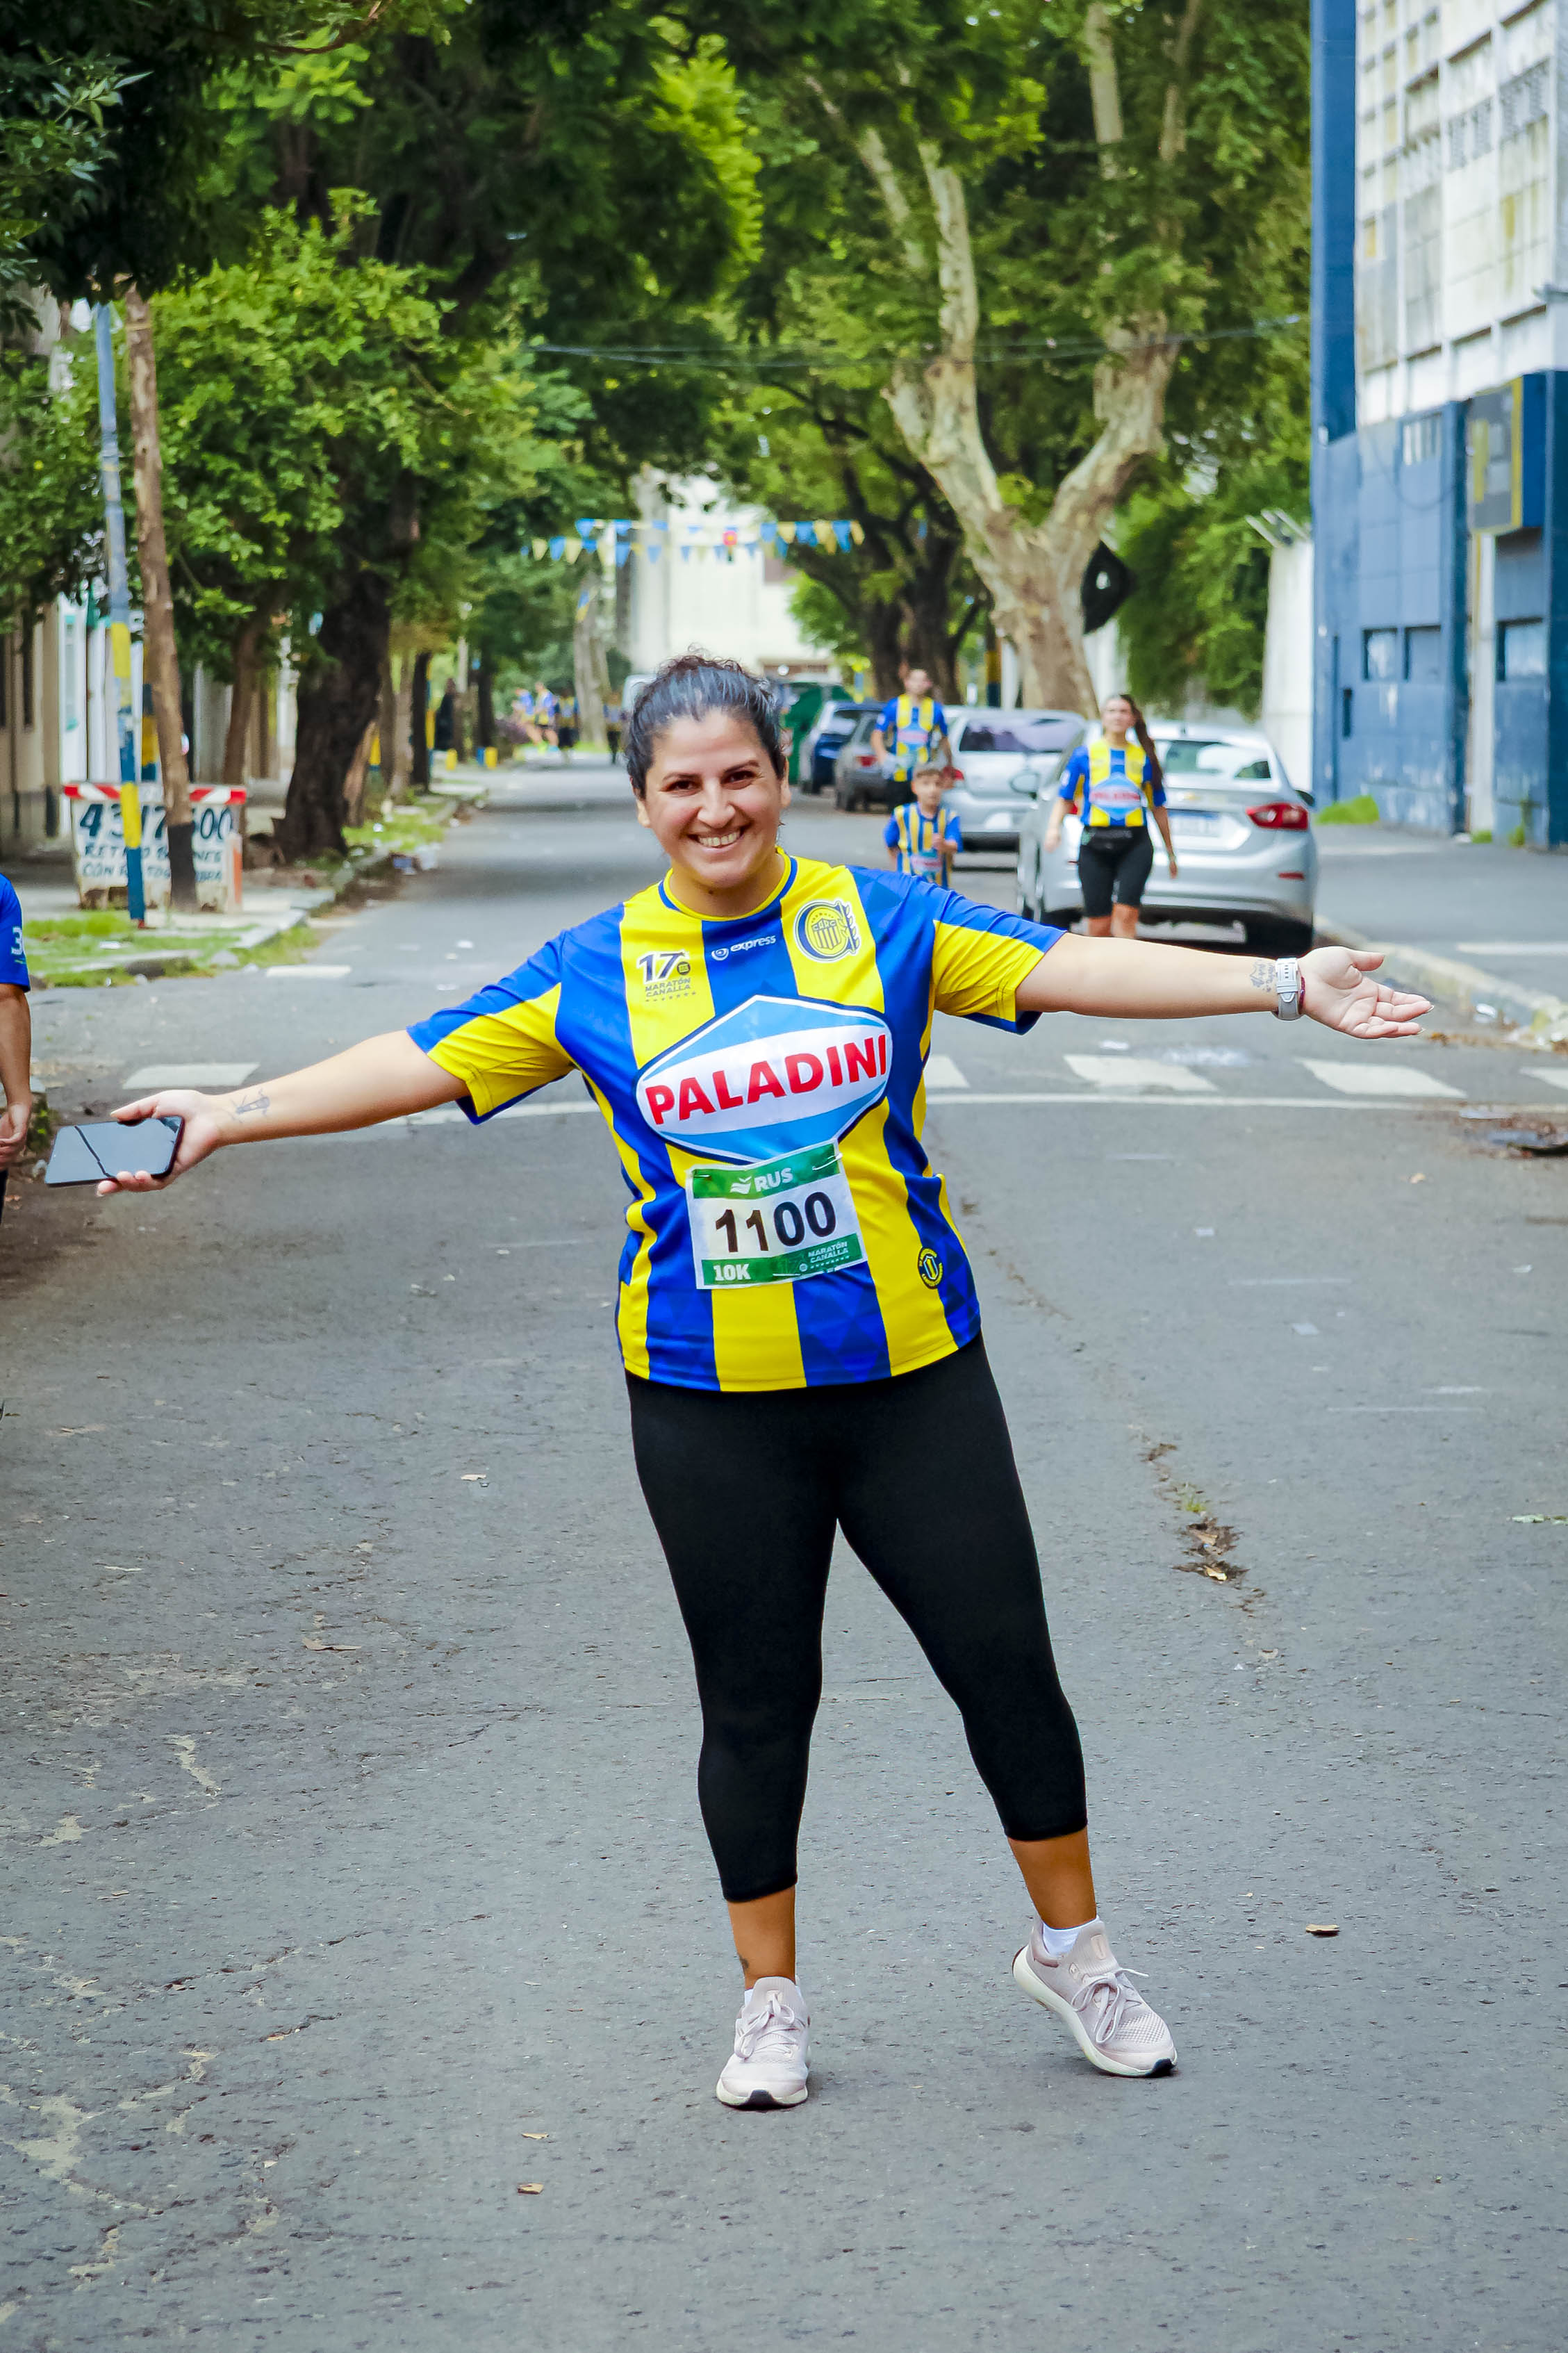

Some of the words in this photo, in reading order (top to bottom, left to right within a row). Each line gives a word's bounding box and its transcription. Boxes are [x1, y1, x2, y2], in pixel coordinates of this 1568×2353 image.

[730, 935, 777, 951] express
[638, 951, 685, 983] 17
[645, 977, 691, 992] MARATÓN
[645, 984, 691, 997] CANALLA
[645, 1034, 886, 1125] PALADINI
[754, 1167, 793, 1192] RUS
[716, 1191, 836, 1253] 1100
[810, 1247, 848, 1263] CANALLA
[713, 1263, 751, 1281] 10K
